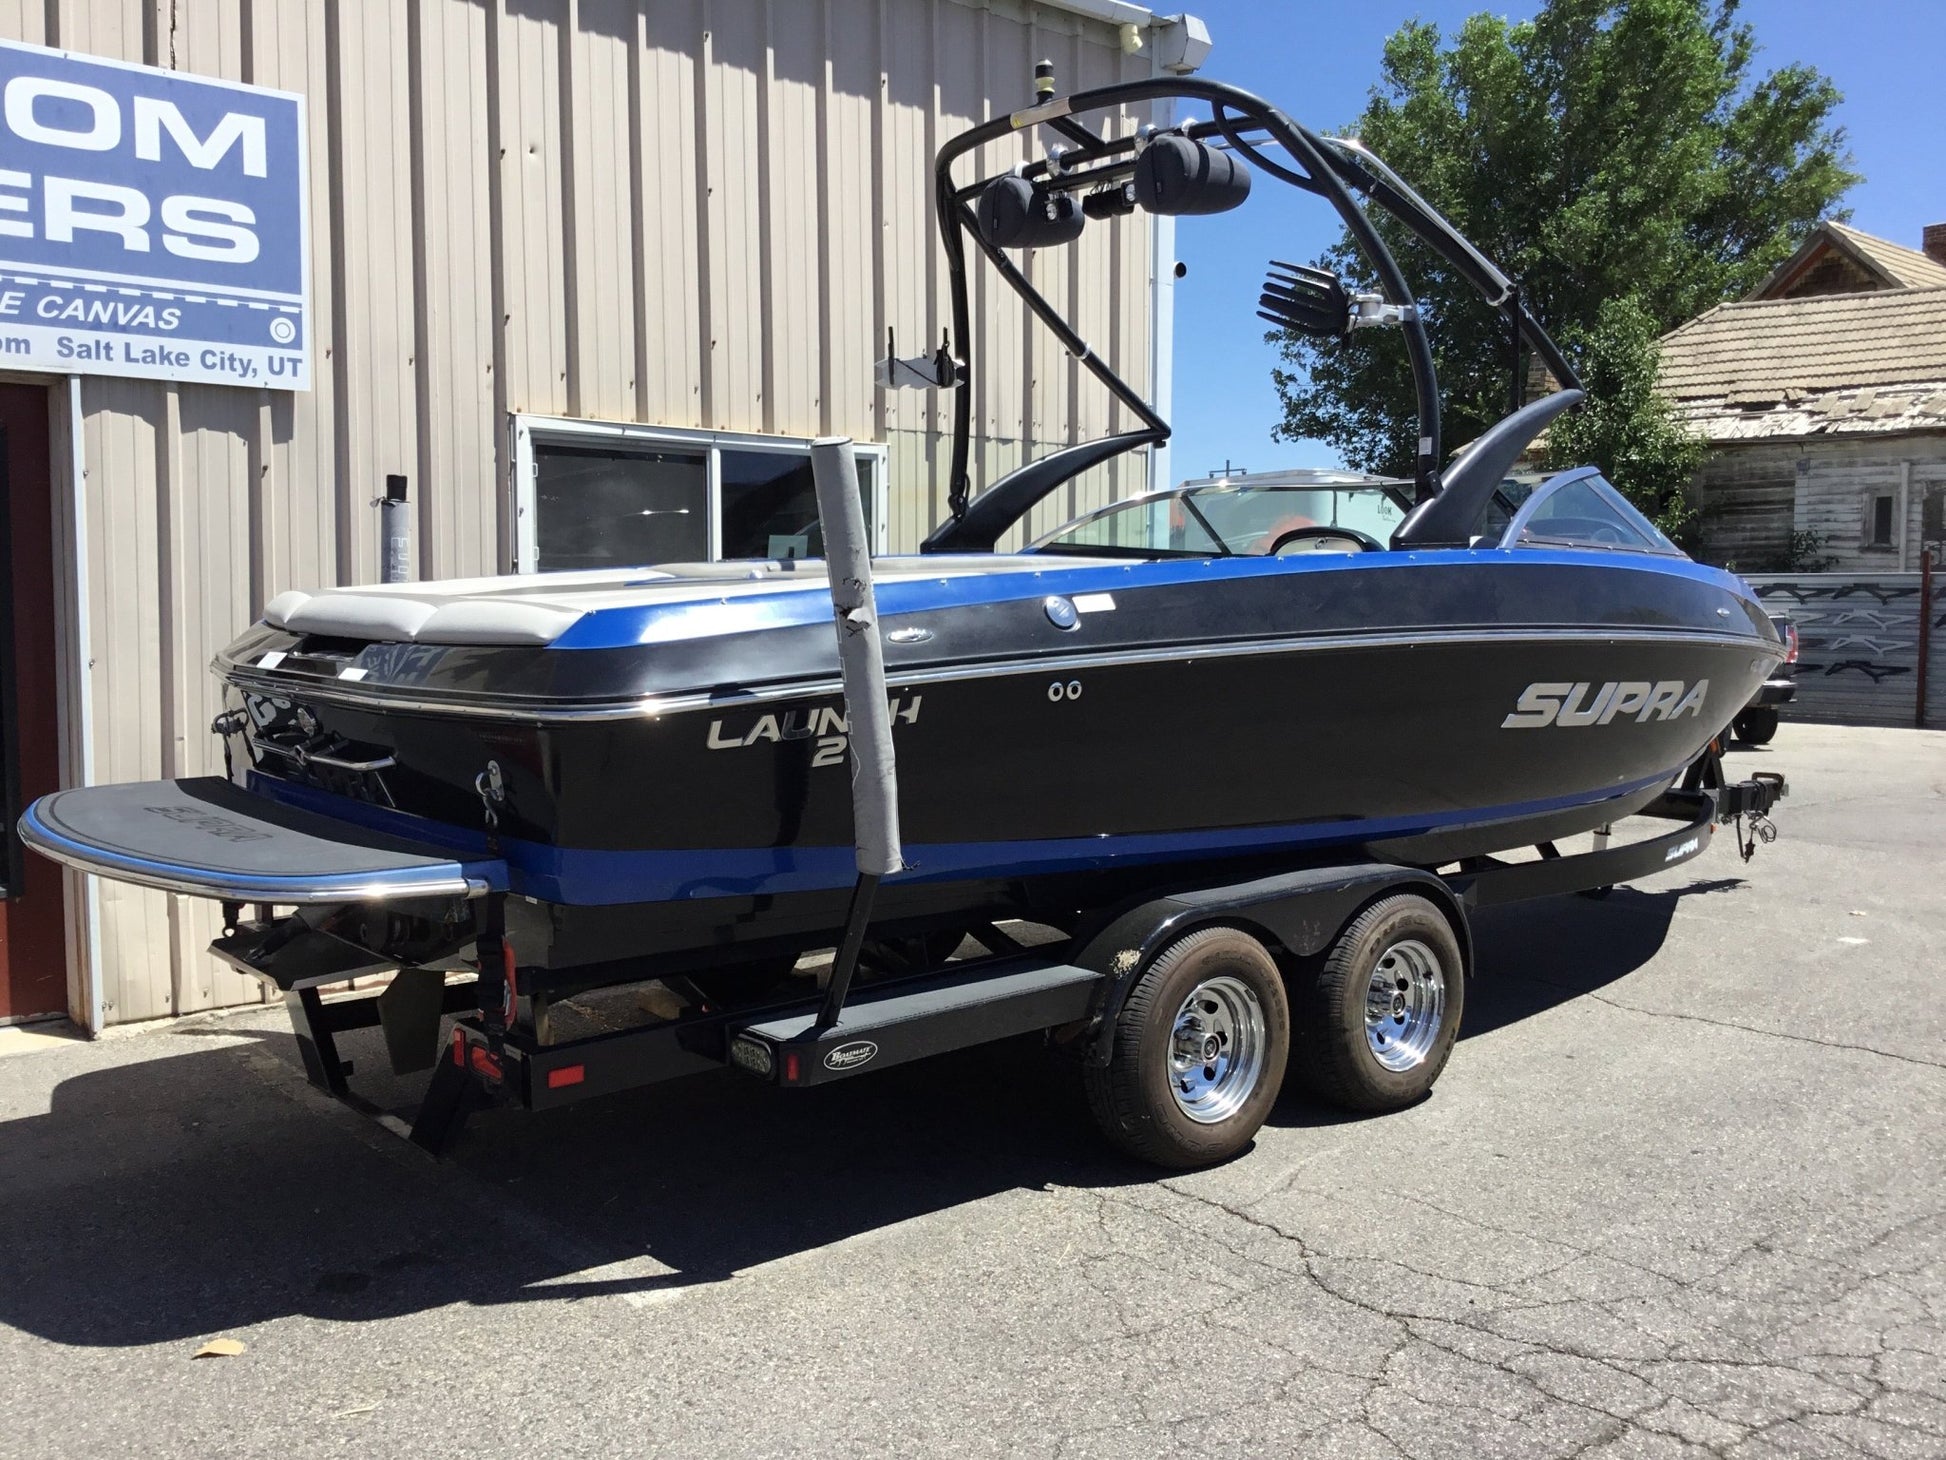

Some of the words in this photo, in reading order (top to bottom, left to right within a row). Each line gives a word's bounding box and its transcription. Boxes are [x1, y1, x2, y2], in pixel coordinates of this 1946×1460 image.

[4, 76, 267, 178] OM
[0, 168, 260, 264] ERS
[37, 296, 182, 330] CANVAS
[56, 336, 114, 362] Salt
[124, 342, 190, 367] Lake
[200, 349, 258, 378] City,
[268, 355, 303, 377] UT
[707, 695, 922, 750] LAUNH
[1500, 679, 1710, 729] SUPRA
